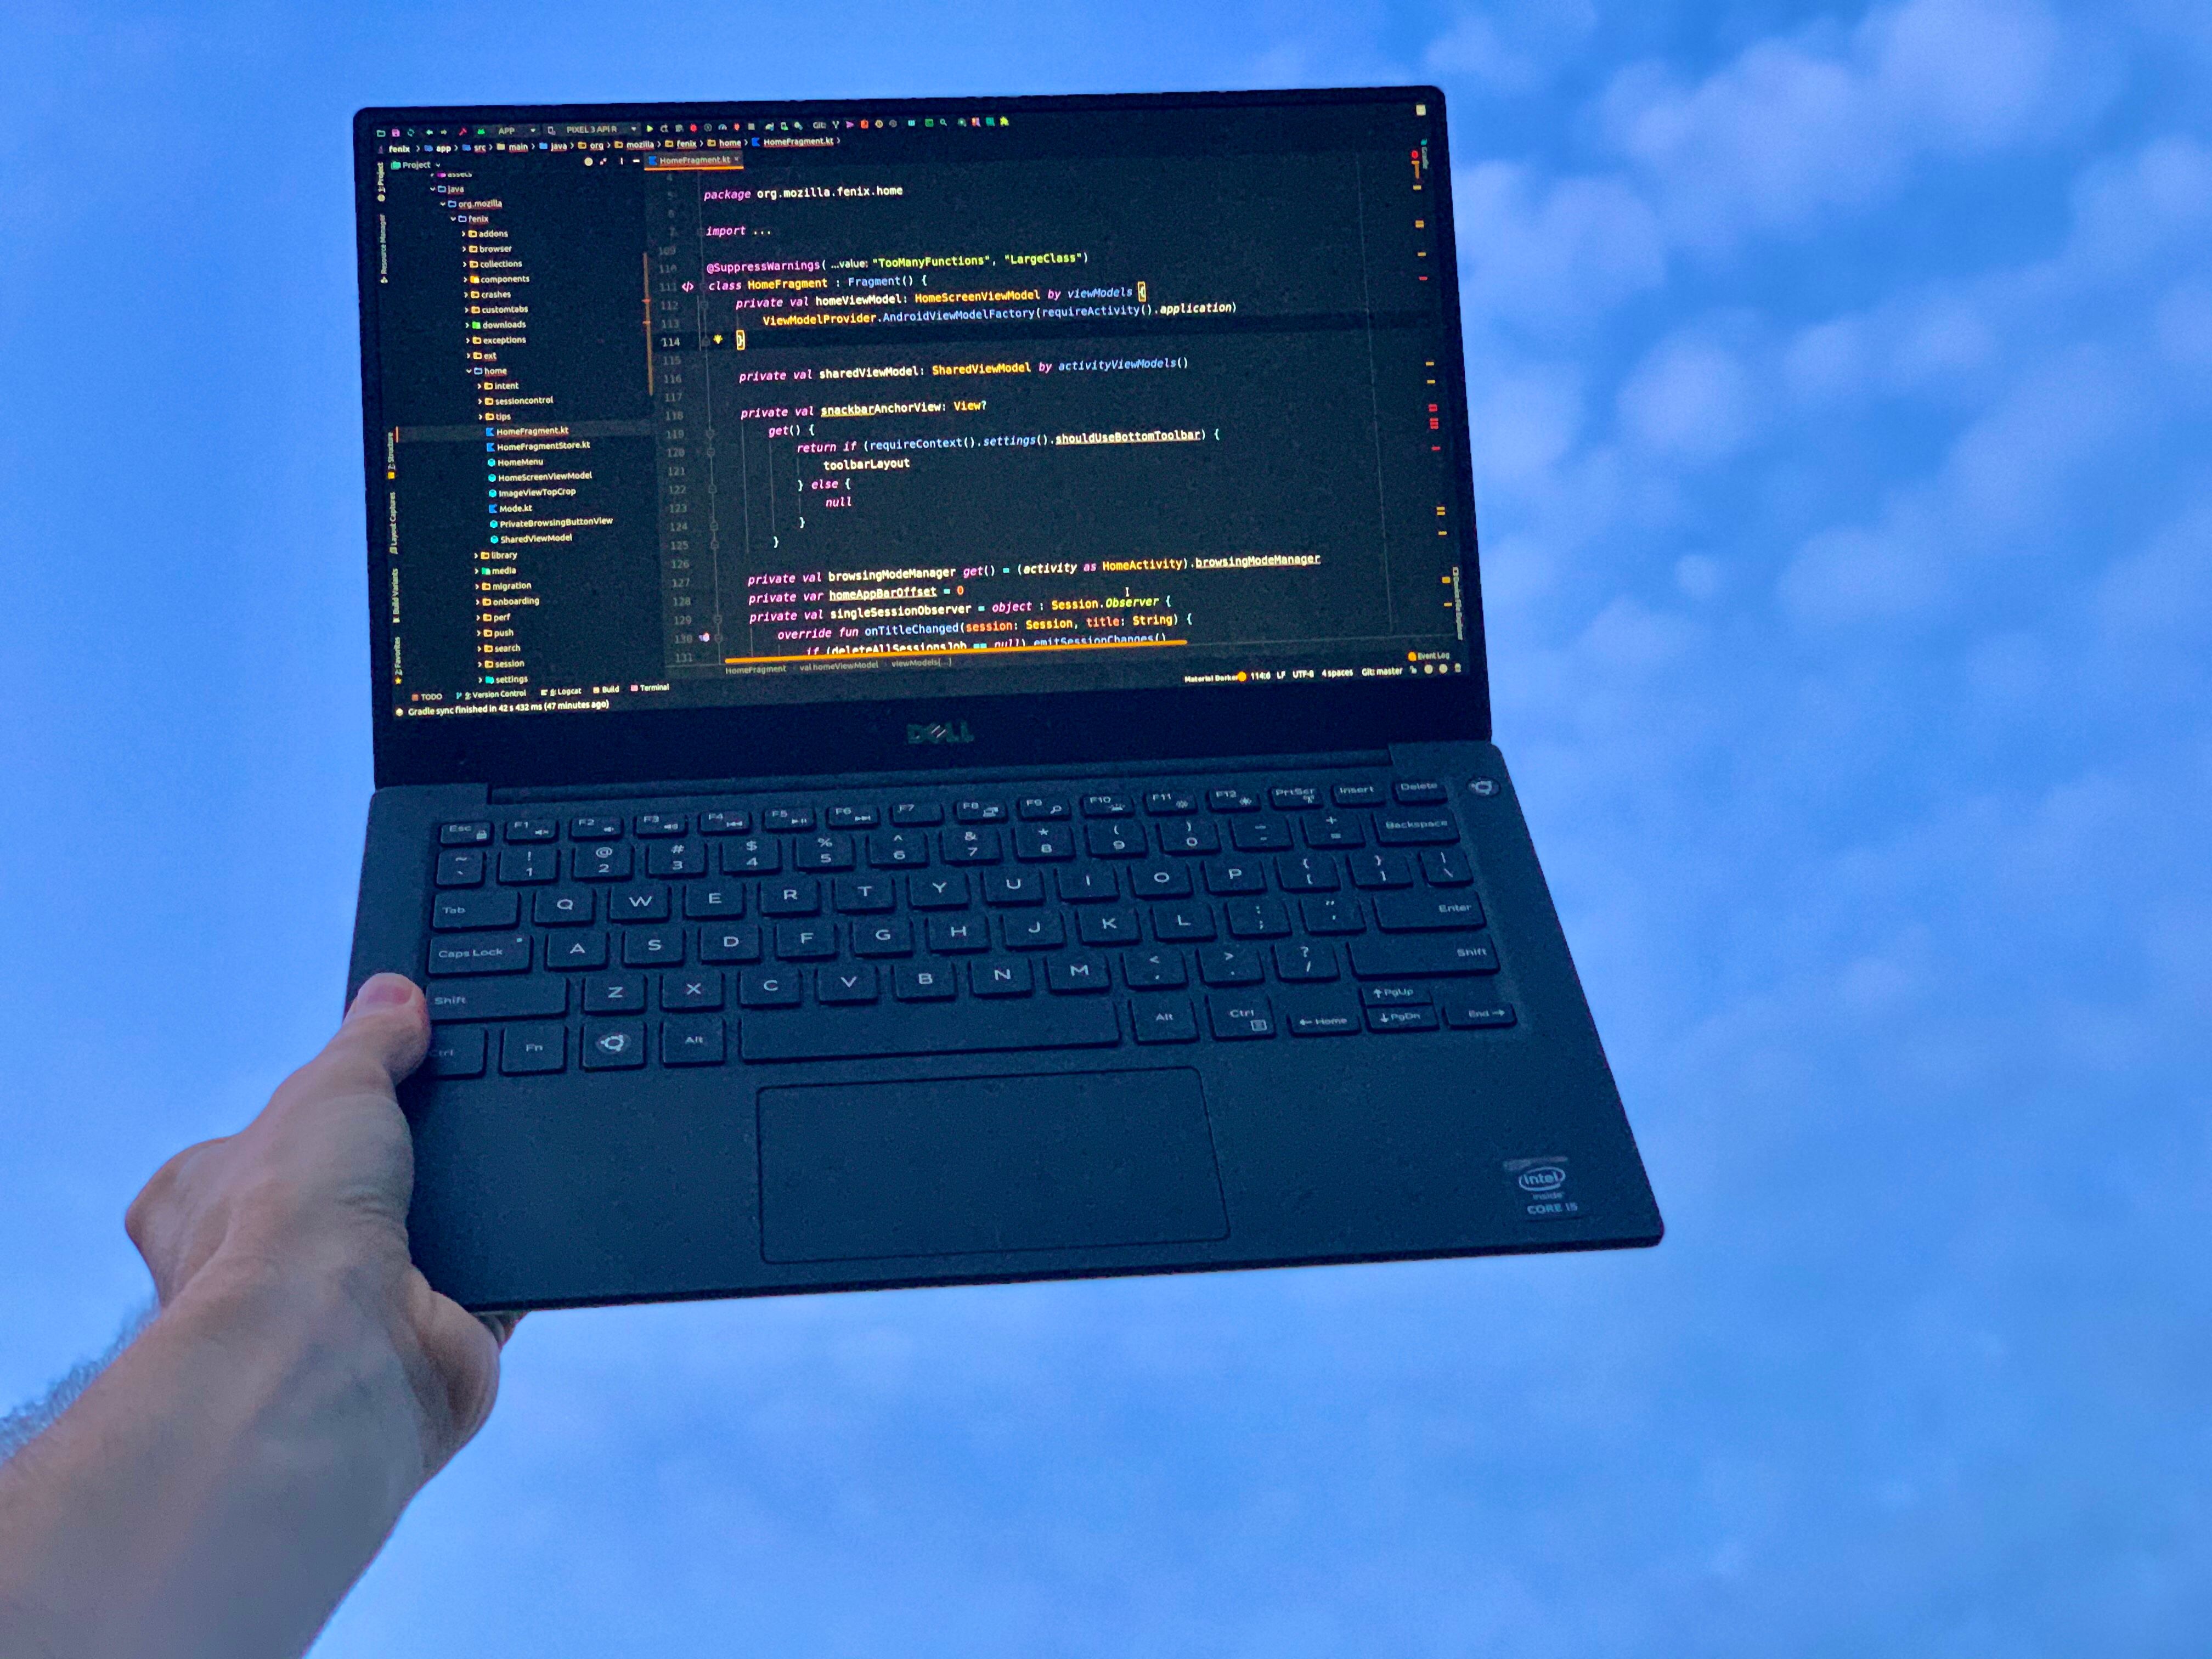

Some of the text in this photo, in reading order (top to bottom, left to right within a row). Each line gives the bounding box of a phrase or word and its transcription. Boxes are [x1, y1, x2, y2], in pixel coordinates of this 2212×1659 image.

[437, 145, 451, 153] app
[551, 142, 567, 151] java
[590, 142, 603, 150] org
[677, 139, 696, 148] fenix
[720, 138, 741, 146] home
[764, 137, 833, 146] HomeFragment.kt
[660, 156, 730, 165] HomeFragment.kt
[448, 185, 464, 194] java
[704, 186, 902, 201] package org.mozilla.fenix.home
[458, 200, 502, 208] org.mozilla
[707, 225, 746, 236] import
[480, 259, 522, 268] collections
[873, 255, 996, 270] "TooManyFunctions",
[1005, 253, 1087, 266] "LargeClass")
[481, 275, 529, 283] components
[709, 276, 913, 290] class HomeFragment Fragment()
[736, 287, 1132, 309] private val homeViewModel: HomeScreenViewModel by viewModels
[482, 305, 528, 313] customtabs
[483, 320, 526, 329] downloads
[483, 336, 526, 345] exceptions
[740, 358, 1188, 383] private val sharedViewModel: SharedViewModel by activityViewModels()
[495, 396, 553, 405] sessioncontrol
[741, 401, 986, 420] private val snackbarAnchorView: View?
[496, 412, 511, 421] tips
[496, 426, 569, 436] HomeFragment.kt
[769, 425, 800, 438] get()
[497, 441, 590, 451] HomeFragmentStore.kt
[797, 443, 836, 453] return
[844, 441, 857, 452] if
[498, 458, 543, 466] HomeMenu
[824, 459, 910, 470] toolbarLayout
[499, 471, 592, 482] HomeScreenViewModel
[812, 479, 838, 489] else
[499, 487, 575, 498] ImageViewTopCrop
[826, 496, 851, 507] null
[499, 504, 532, 512] Mode.kt
[500, 516, 613, 529] PrivateBrowsingButtonView
[501, 534, 572, 544] SharedViewModel
[492, 551, 517, 560] library
[748, 574, 795, 587] private
[803, 573, 822, 583] val
[828, 568, 956, 582] browsingModeManager
[963, 566, 995, 579] get()
[1018, 562, 1077, 575] (activity
[1084, 562, 1096, 572] as
[493, 582, 531, 591] migration
[493, 596, 539, 606] onboarding
[749, 592, 796, 606] private
[804, 592, 824, 601] var
[830, 586, 937, 602] homeAppBarOffset
[750, 597, 1159, 624] private val singleSessionObserver object Session.Observer
[494, 613, 510, 622] perf
[778, 629, 832, 640] override
[840, 627, 859, 637] fun
[1026, 618, 1077, 631] Session,
[1086, 616, 1125, 627] title:
[1133, 613, 1177, 627] String)
[494, 629, 514, 638] push
[496, 675, 528, 684] settings
[558, 687, 581, 696] Logcat
[602, 685, 619, 693] Build
[640, 683, 669, 692] Terminal
[473, 689, 526, 698] Version Control
[408, 707, 435, 716] Gradle
[436, 707, 453, 716] sync
[455, 704, 487, 714] finished
[544, 702, 556, 710] (47
[558, 701, 590, 709] minutes
[591, 699, 609, 709] ago)
[907, 720, 974, 744] DELL
[1154, 873, 1169, 882] O
[1229, 868, 1242, 879] P
[933, 882, 947, 893] Y
[1006, 879, 1021, 889] U
[784, 889, 797, 899] R
[857, 887, 872, 896] T
[629, 896, 652, 906] W
[709, 893, 722, 904] E
[557, 899, 573, 910] Q
[1439, 905, 1471, 913] Enter
[1103, 918, 1117, 929] K
[1178, 915, 1191, 926] L
[951, 926, 966, 937] H
[1029, 922, 1040, 933] J
[800, 933, 814, 944] F
[876, 930, 890, 940] G
[648, 940, 661, 950] S
[724, 936, 738, 947] D
[570, 943, 585, 953] A
[439, 950, 470, 958] Caps
[995, 969, 1011, 980] N
[1070, 965, 1088, 976] M
[841, 977, 856, 988] V
[918, 973, 932, 984] B
[687, 983, 701, 995] X
[764, 980, 778, 991] C
[608, 987, 623, 997] Z
[435, 996, 466, 1005] Shift
[1527, 1204, 1562, 1214] CORE
